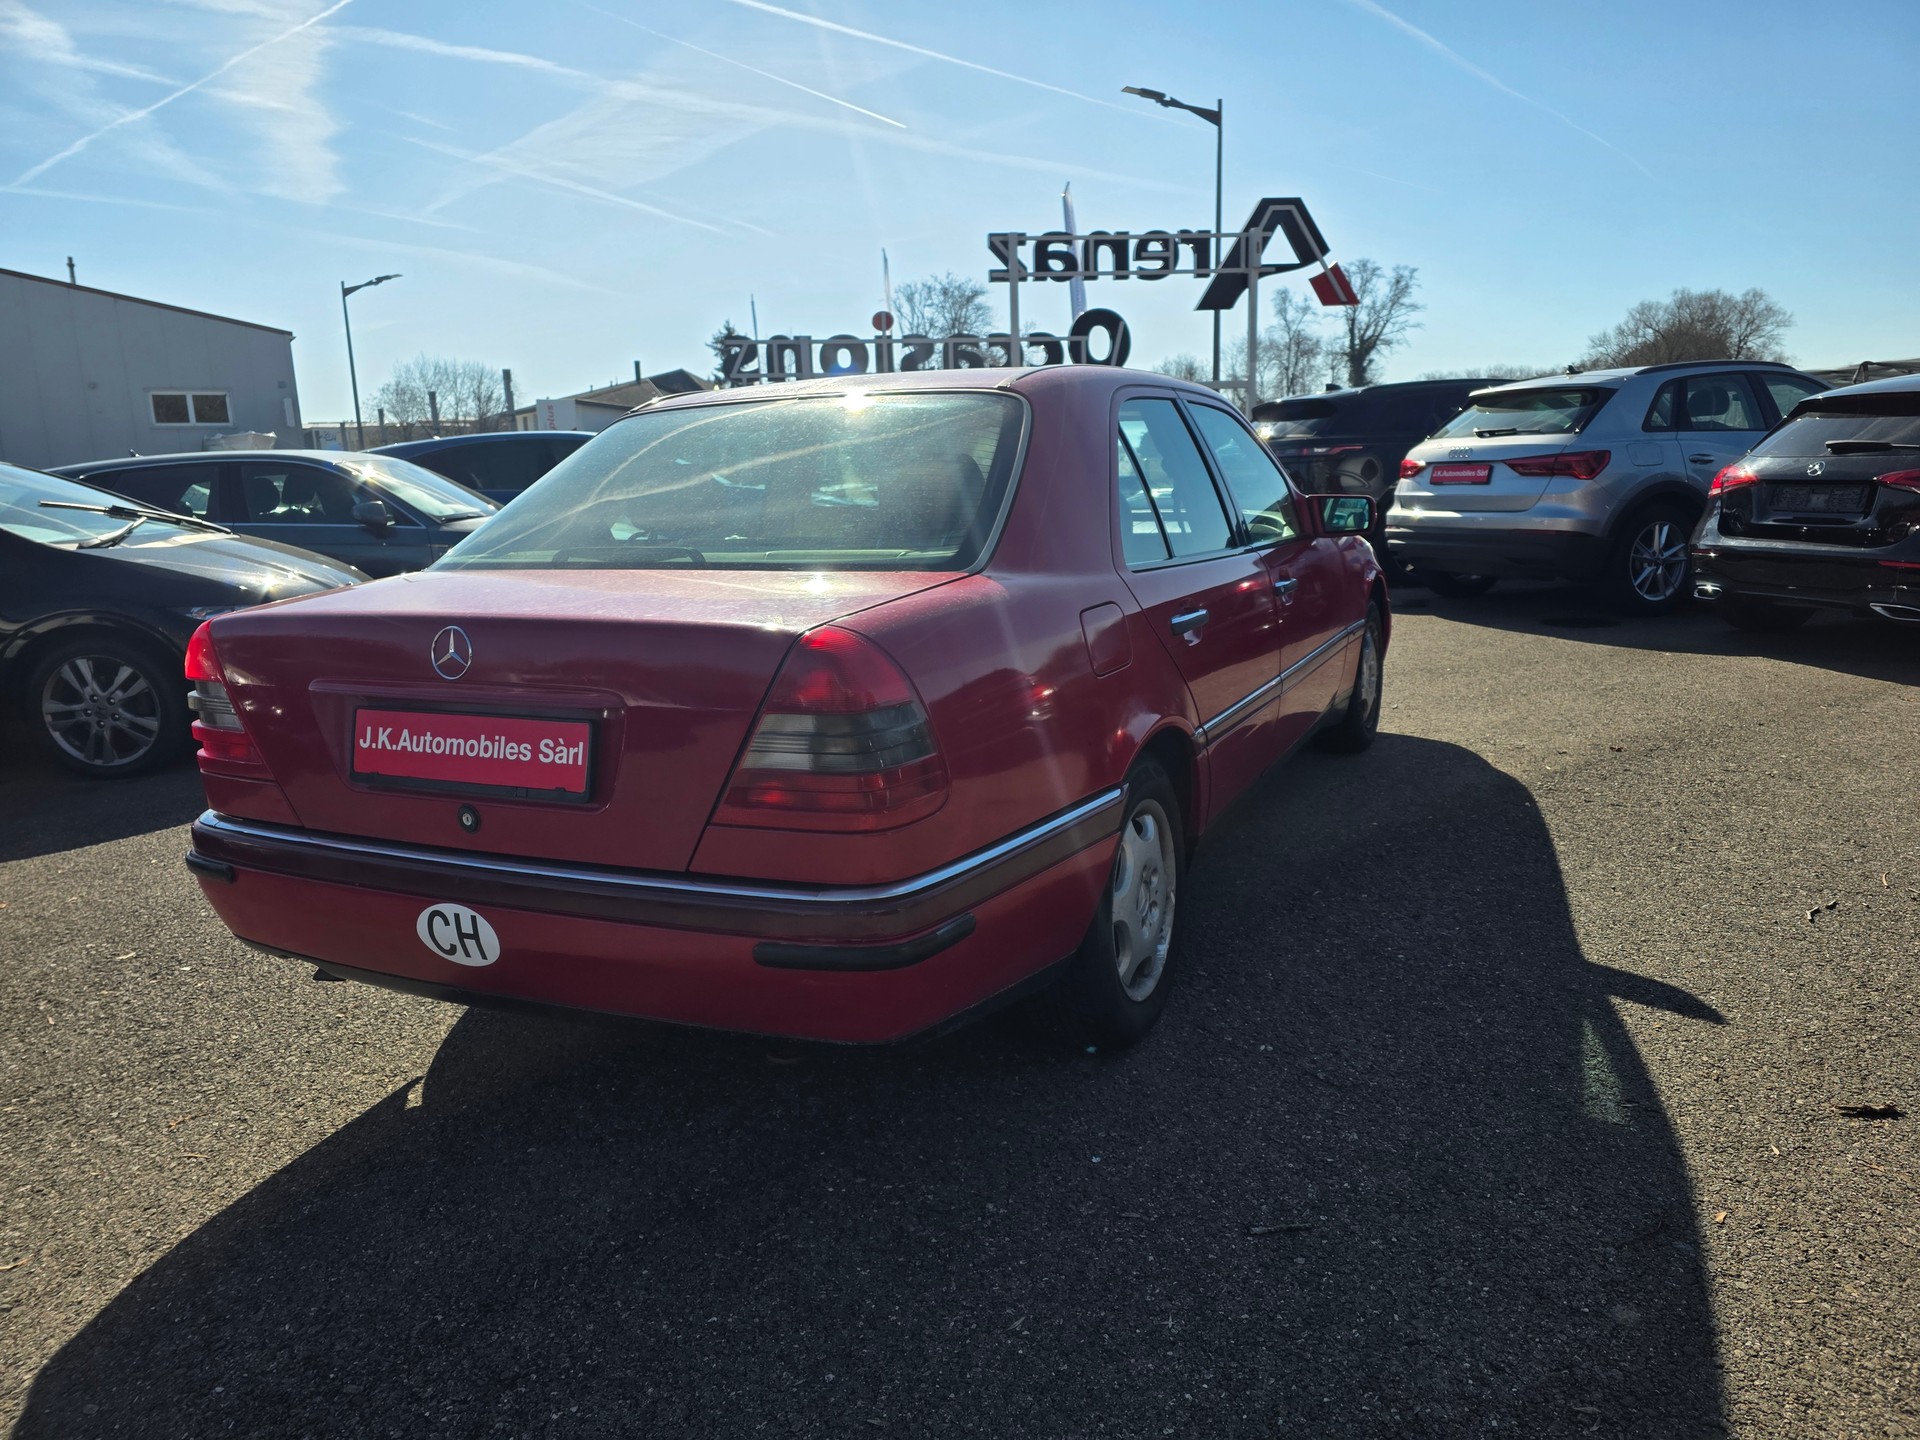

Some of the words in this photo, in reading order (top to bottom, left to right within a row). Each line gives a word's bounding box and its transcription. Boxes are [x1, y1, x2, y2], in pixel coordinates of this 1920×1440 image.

[359, 726, 532, 762] J.K.Automobiles
[538, 737, 584, 766] Sàrl
[427, 909, 488, 961] CH
